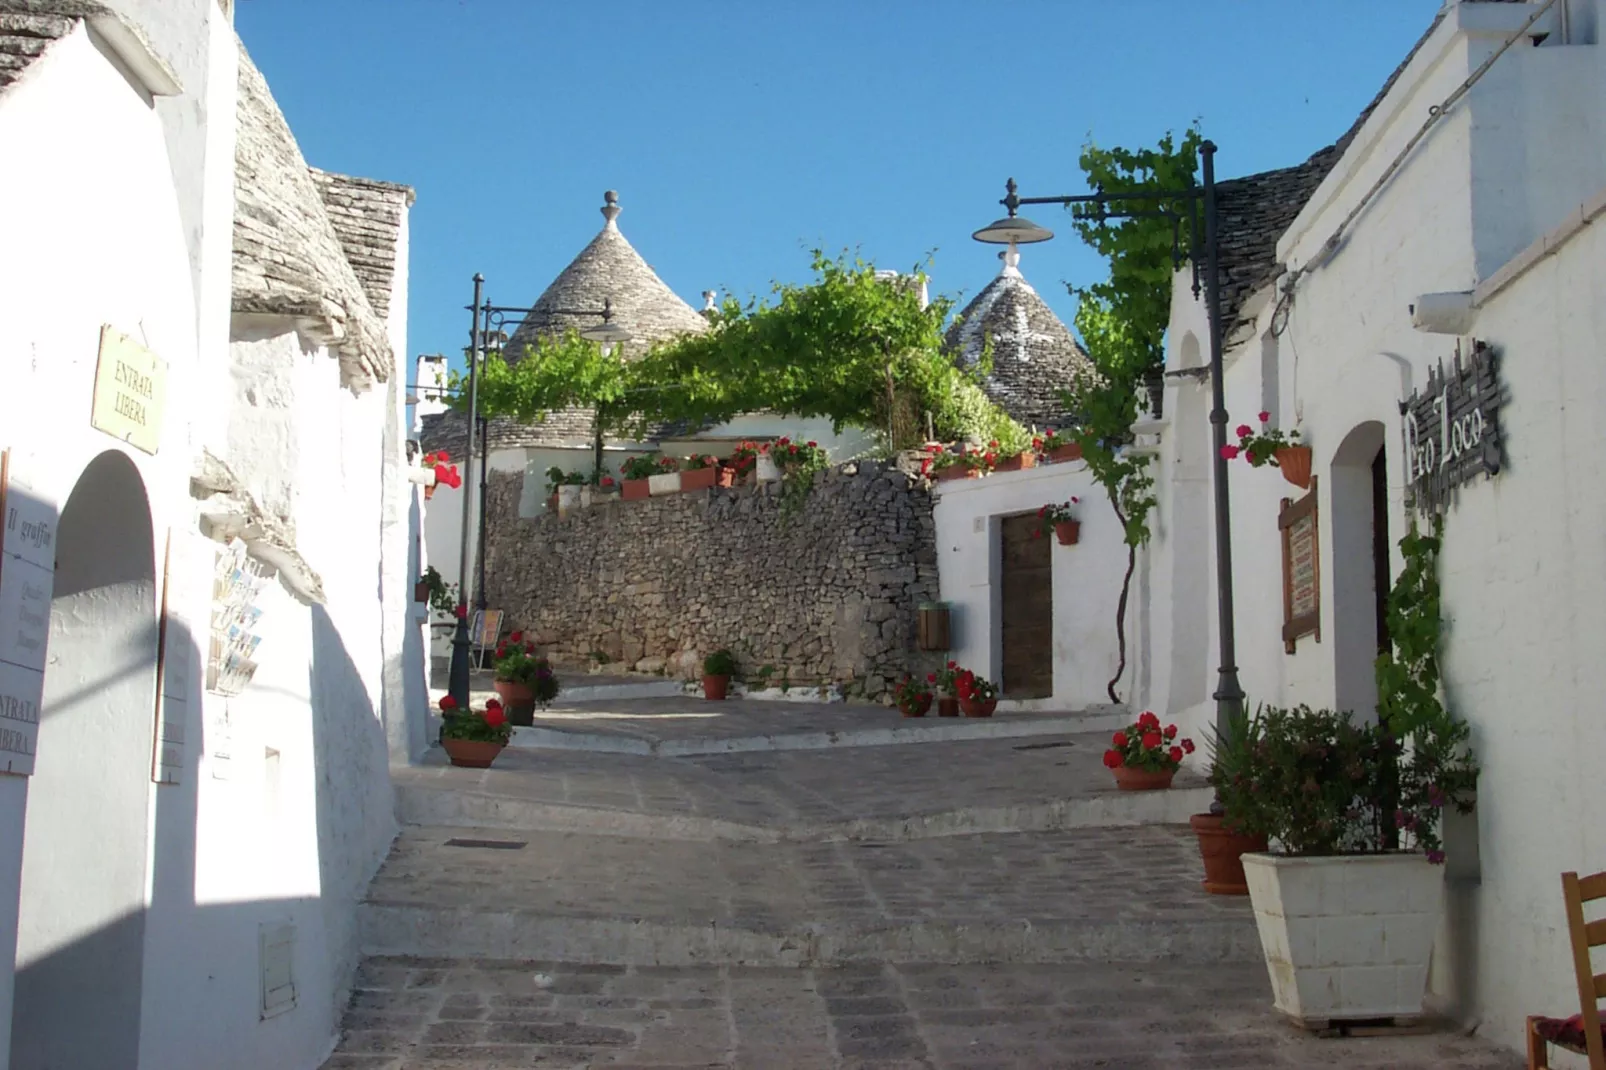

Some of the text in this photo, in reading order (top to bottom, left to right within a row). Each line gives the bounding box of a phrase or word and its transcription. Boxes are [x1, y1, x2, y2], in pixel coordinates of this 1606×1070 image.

[114, 359, 153, 400] ENTRATA
[114, 391, 147, 426] LIBERA
[1404, 384, 1485, 486] Pro Loco
[8, 507, 18, 532] Il
